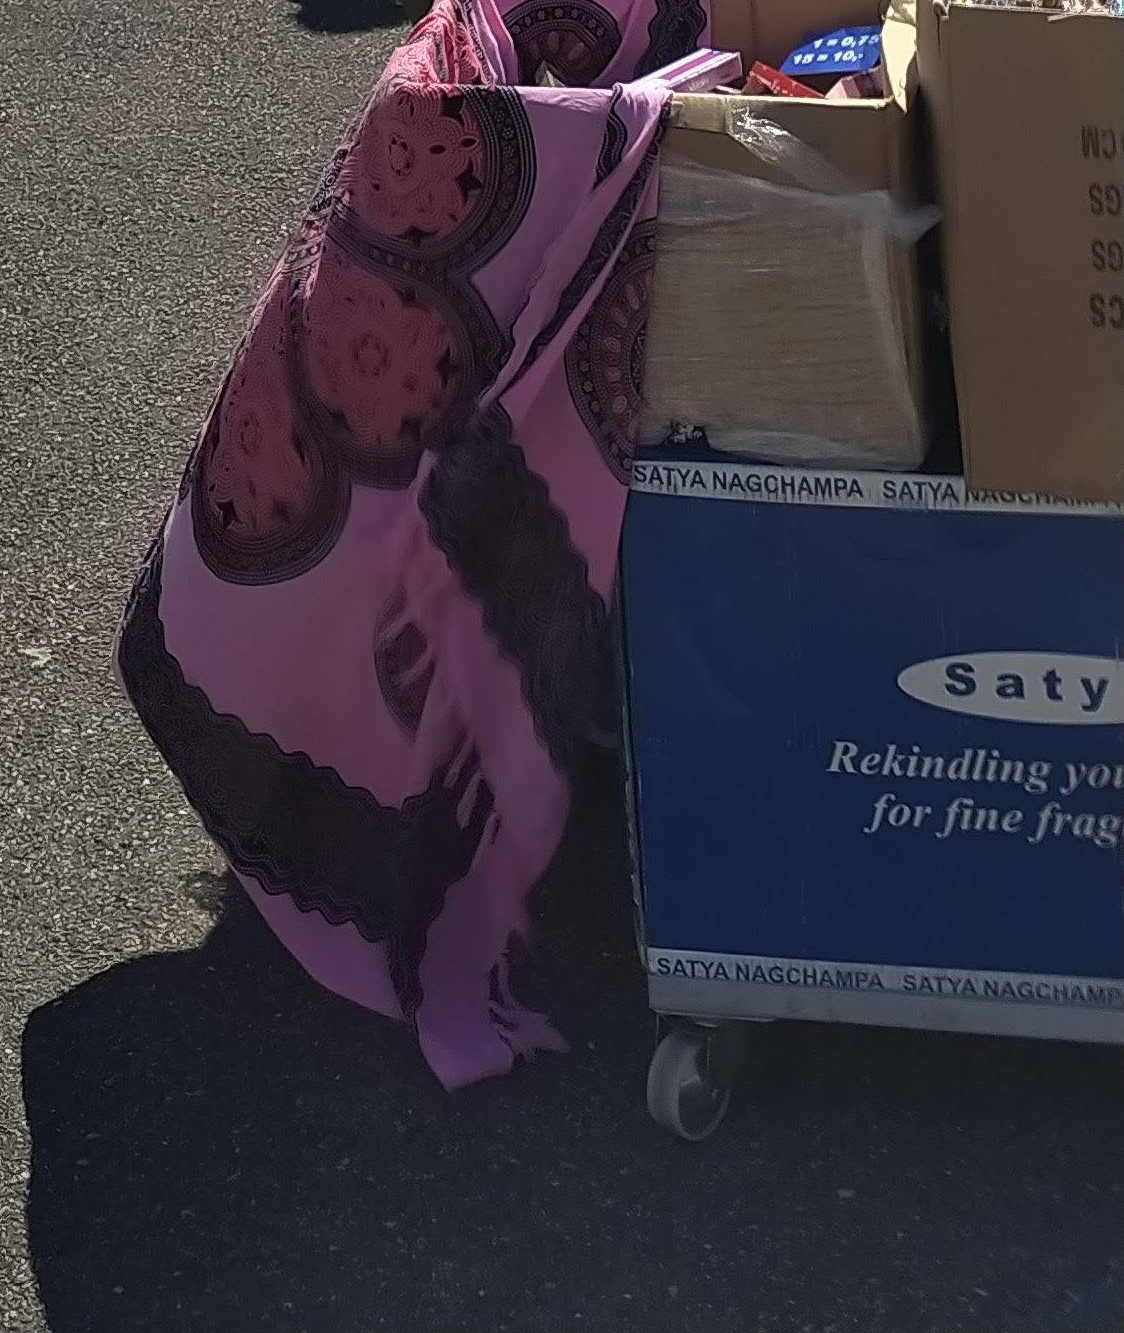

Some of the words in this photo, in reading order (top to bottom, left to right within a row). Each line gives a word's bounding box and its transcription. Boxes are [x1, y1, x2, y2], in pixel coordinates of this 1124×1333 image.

[793, 53, 815, 65] 15
[1089, 183, 1124, 217] GS
[633, 464, 707, 490] SATYA
[712, 470, 864, 498] NAGCHAMPA
[882, 479, 960, 504] SATYA
[944, 661, 1110, 713] Saty
[826, 740, 1052, 794] Rekindling
[863, 792, 932, 834] for
[935, 796, 1024, 839] fine
[1027, 801, 1124, 848] frag
[656, 957, 730, 981] SATYA
[735, 963, 885, 991] NAGCHAMPA
[902, 973, 977, 996] SATYA
